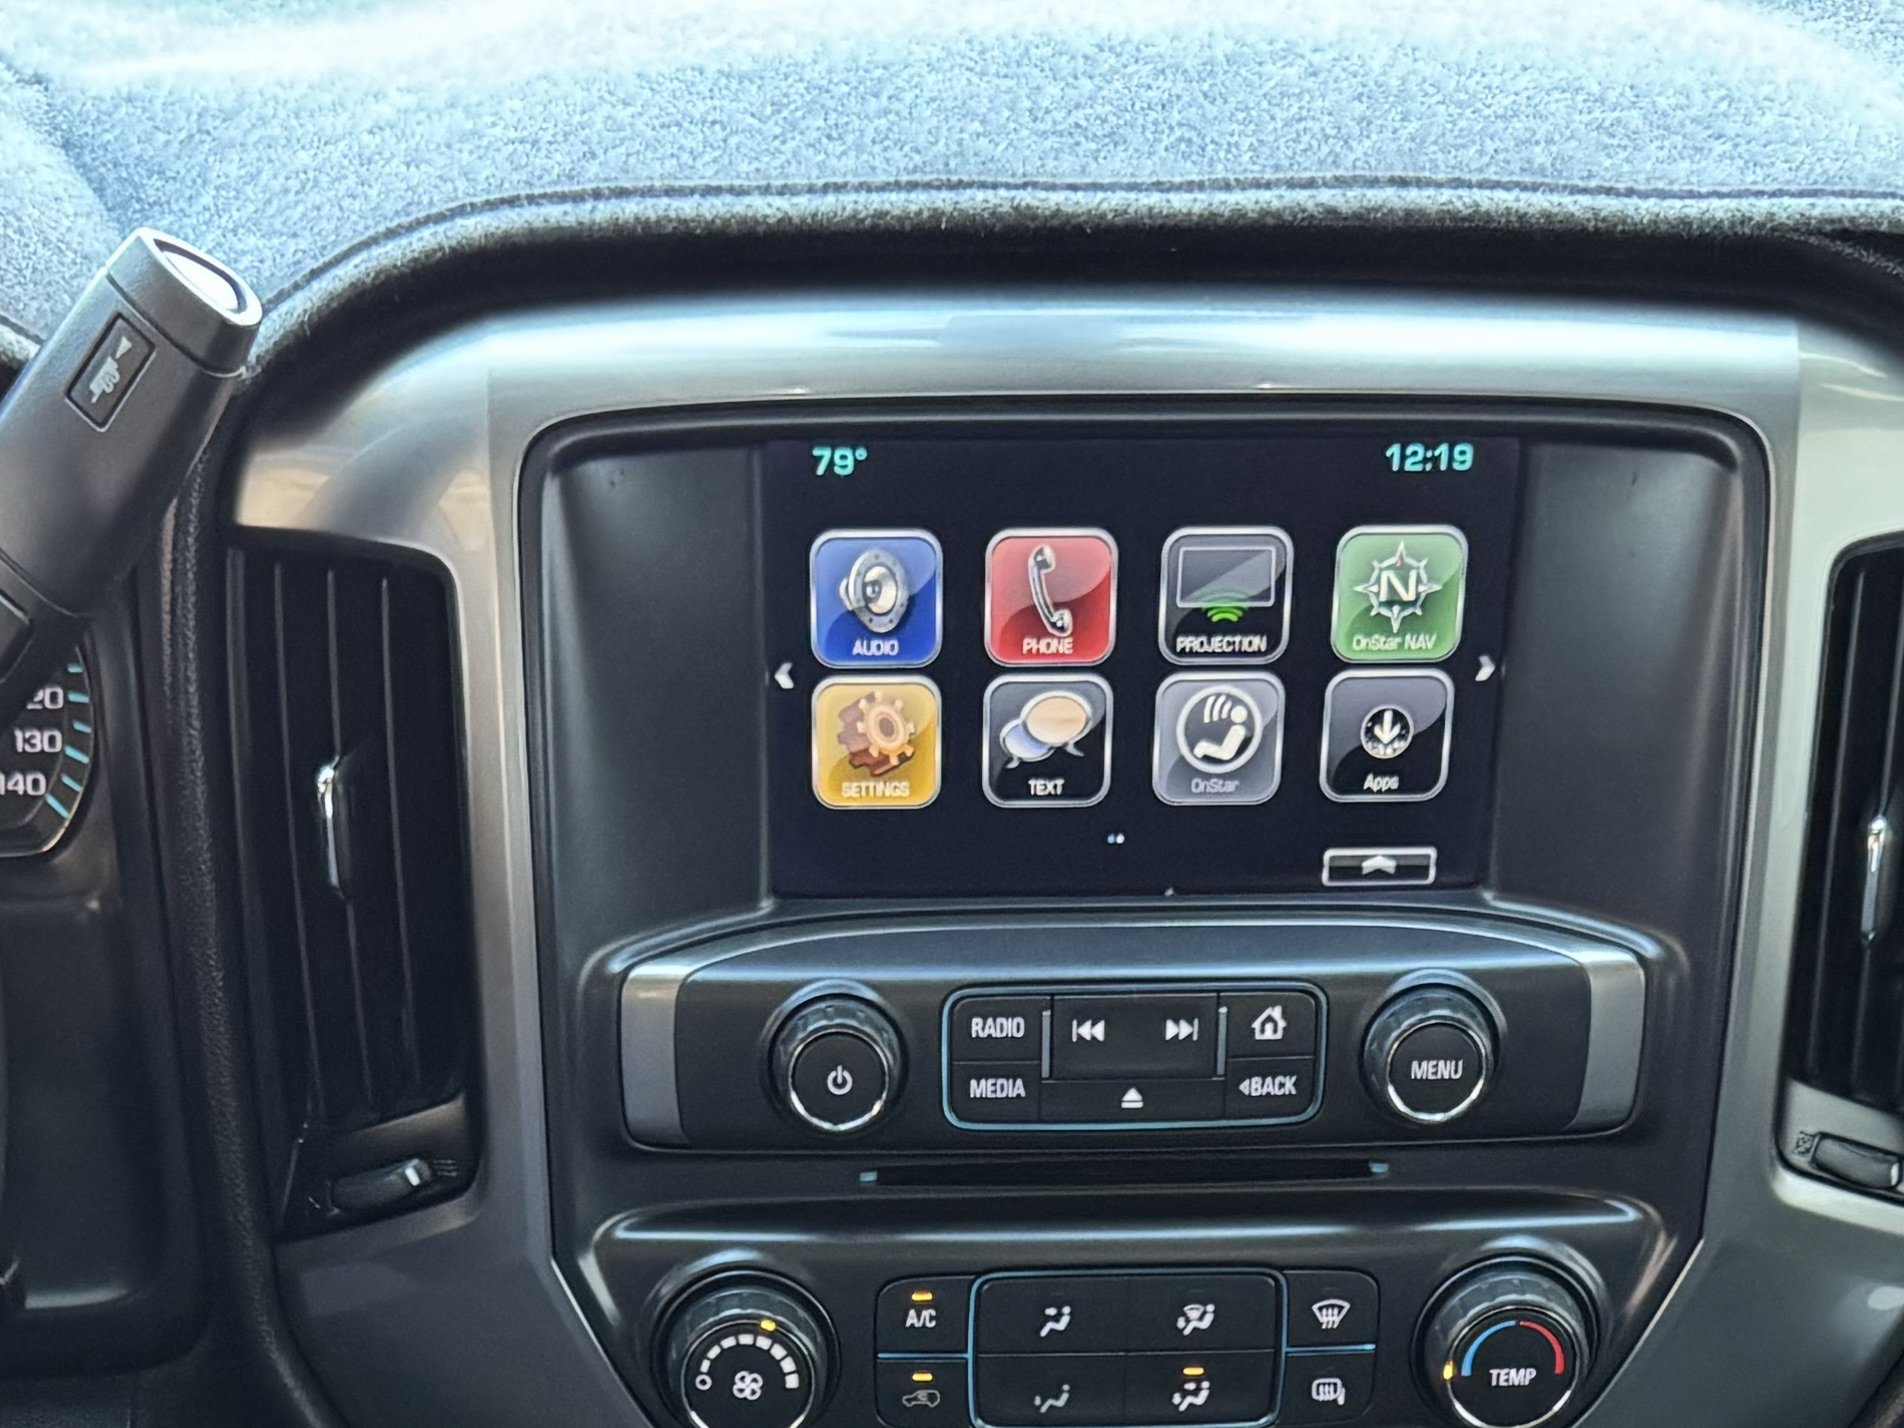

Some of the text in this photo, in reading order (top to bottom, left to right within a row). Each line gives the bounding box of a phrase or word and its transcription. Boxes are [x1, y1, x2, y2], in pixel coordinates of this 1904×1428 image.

[1385, 443, 1474, 471] 12:19
[852, 638, 899, 657] AUDIO
[1022, 636, 1074, 655] PHONE
[1175, 633, 1267, 654] PROJECTION
[1352, 633, 1438, 652] OnStar NAV
[26, 686, 64, 710] 20
[14, 729, 63, 753] 130
[841, 781, 911, 798] SETTINGS
[1028, 778, 1066, 796] TEXT
[1191, 777, 1240, 793] OnStar
[1364, 774, 1400, 792] Apps
[971, 1016, 1026, 1039] RADIO
[1411, 1059, 1464, 1080] MENU
[969, 1078, 1027, 1099] MEDIA
[1250, 1075, 1298, 1096] BACK
[905, 1308, 937, 1329] A/C
[1489, 1367, 1538, 1387] TEMP
